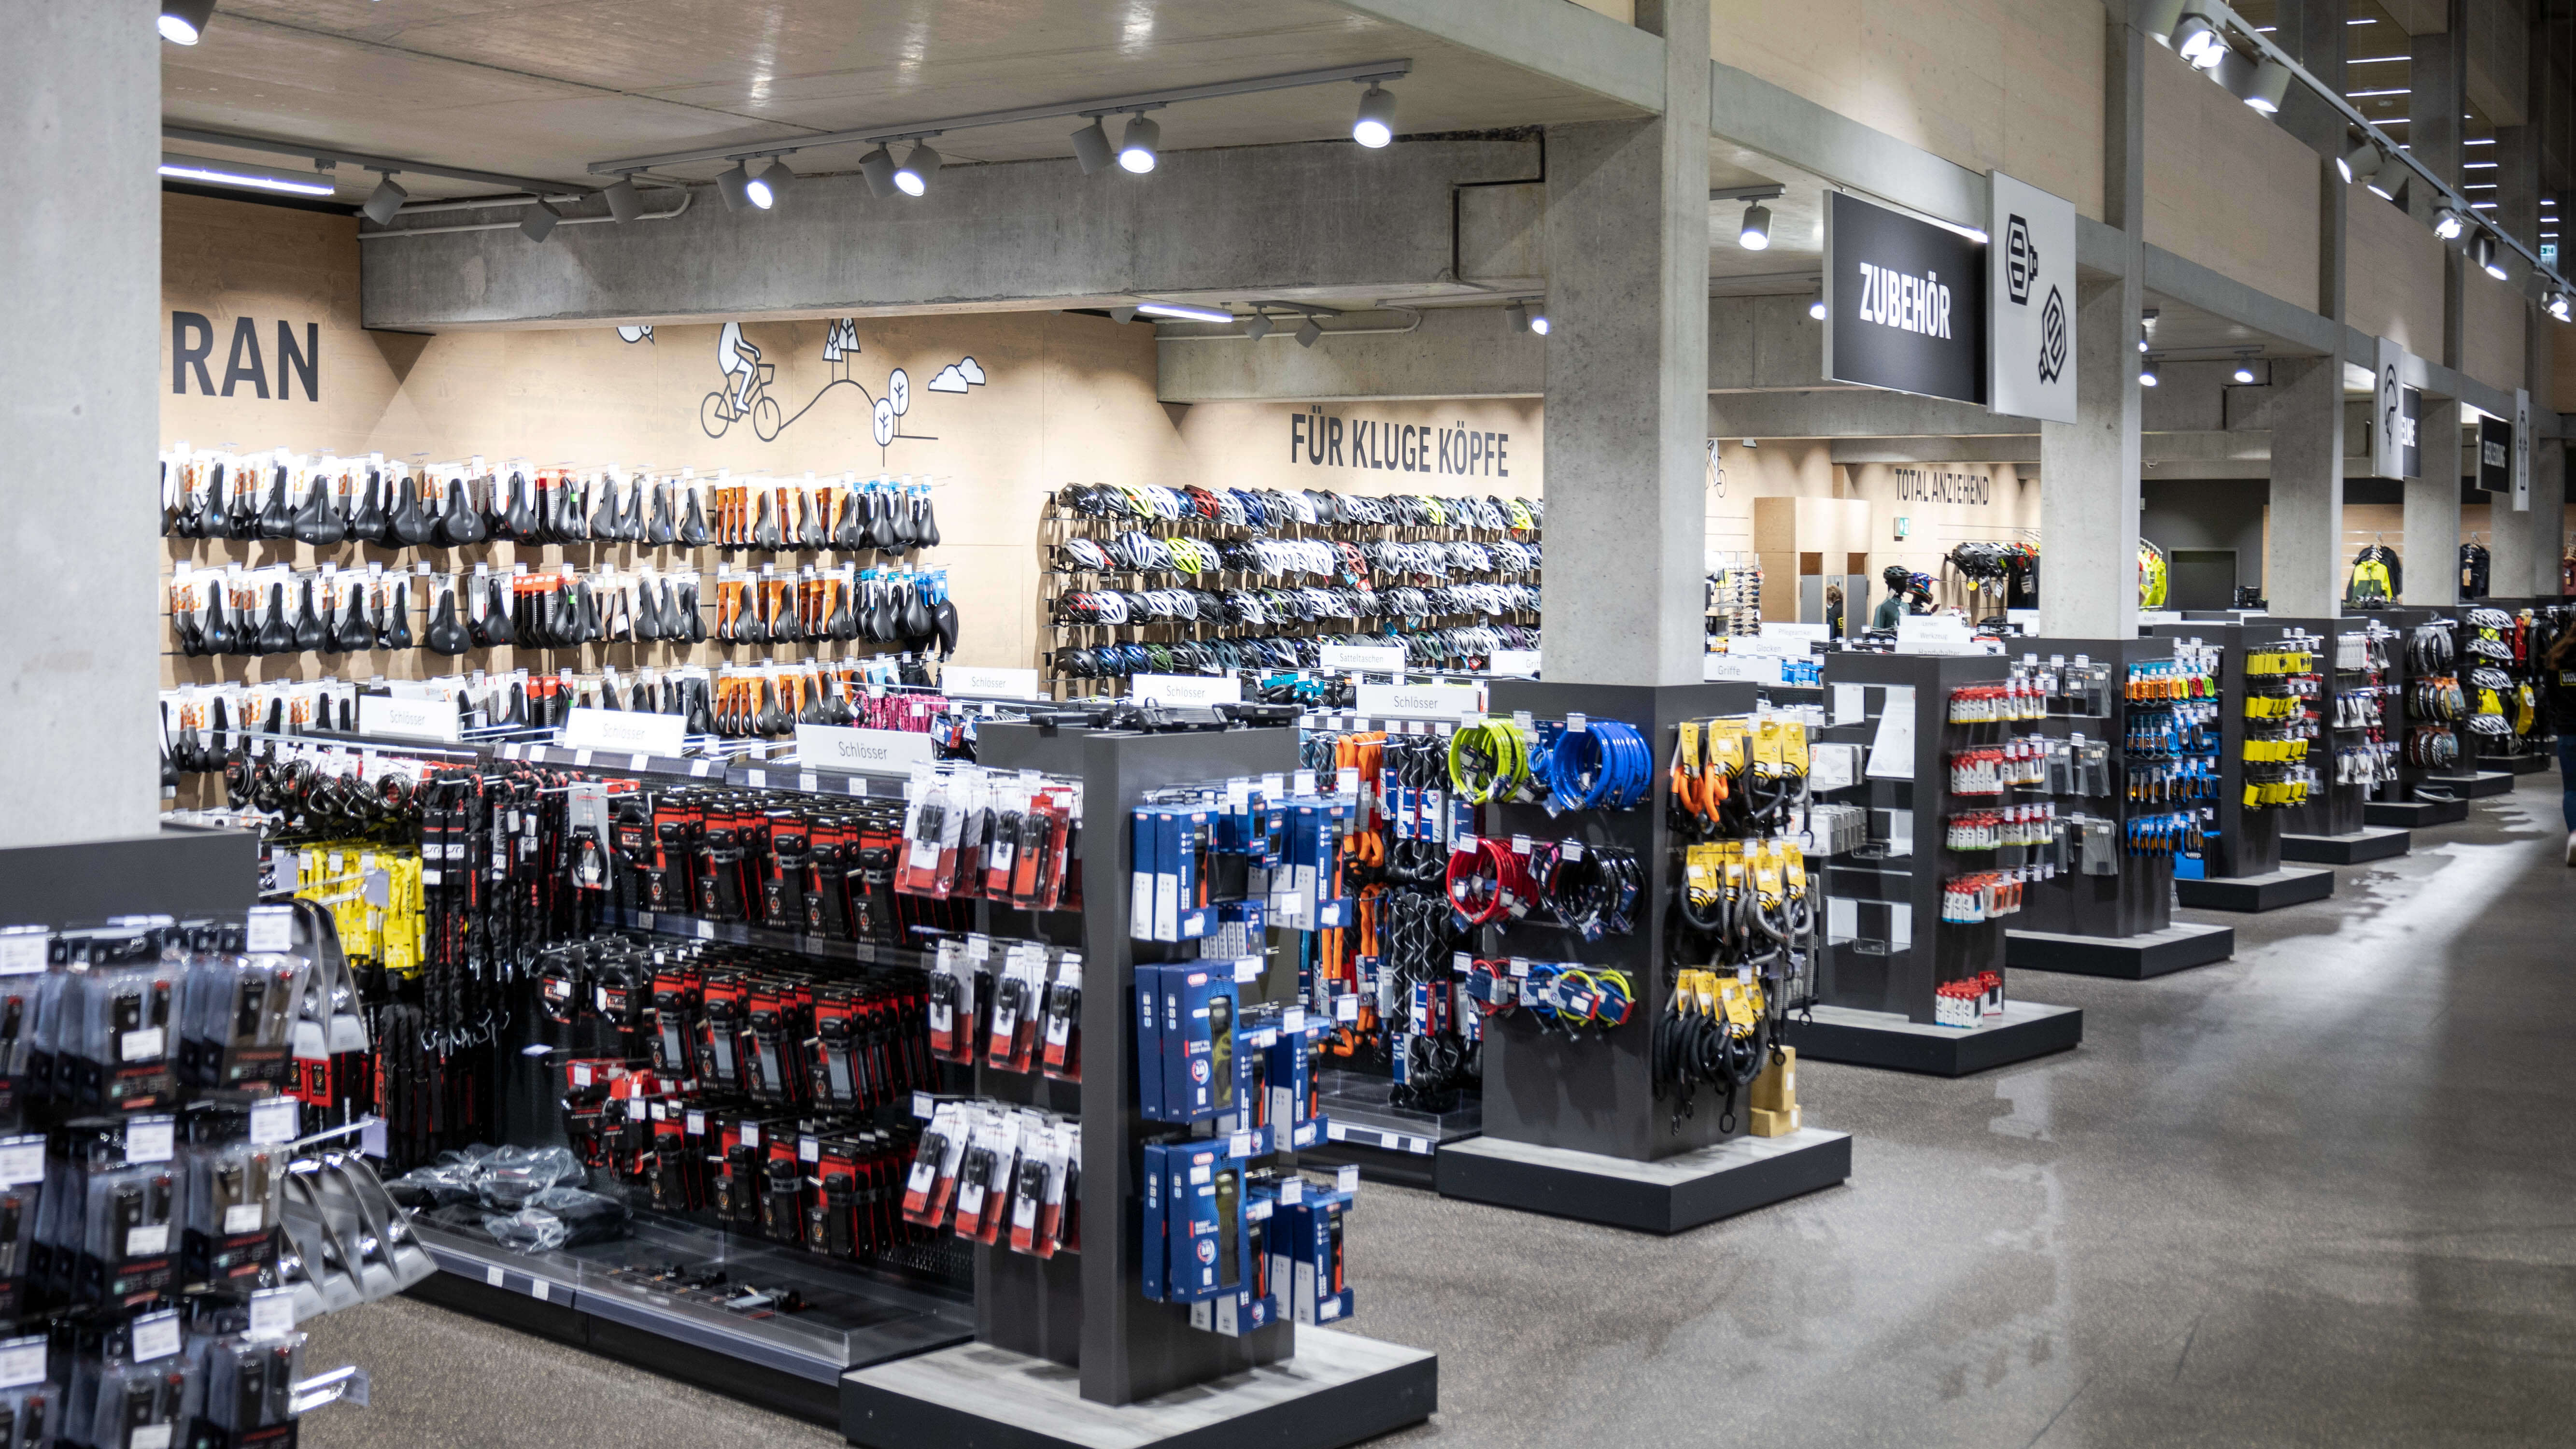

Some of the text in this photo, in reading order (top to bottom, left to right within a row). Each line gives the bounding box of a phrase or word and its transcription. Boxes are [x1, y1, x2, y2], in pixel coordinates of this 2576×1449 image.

[1859, 262, 1951, 340] ZUBEHÖR
[172, 310, 318, 402] RAN
[1292, 405, 1509, 477] FÜR KLUGE KÖPFE
[1896, 468, 1989, 506] TOTAL ANZIEHEND
[1920, 632, 1948, 640] Werkzeug
[1756, 644, 1782, 652] Glocken
[1340, 653, 1384, 664] Satteltaschen
[1718, 665, 1741, 676] Griffe
[971, 676, 1006, 688] Schlösser
[1166, 685, 1205, 699] Schlösser
[1394, 696, 1438, 709] Schlösser
[389, 709, 425, 726] Schlösser
[838, 740, 888, 760] Schlösser
